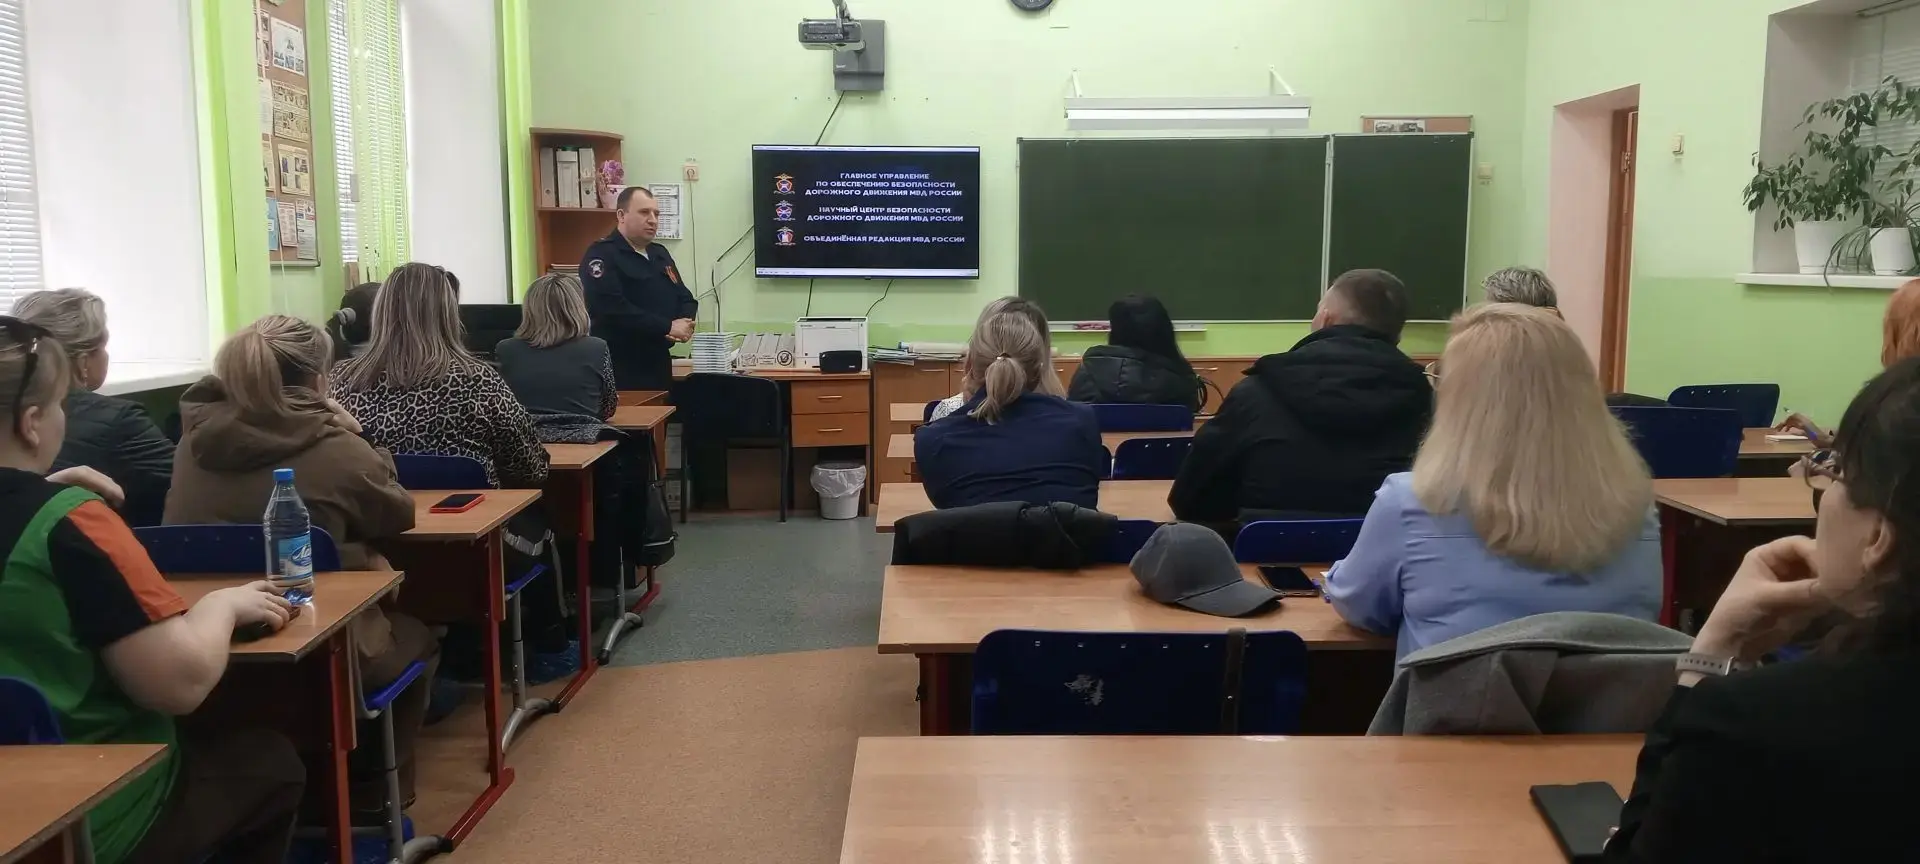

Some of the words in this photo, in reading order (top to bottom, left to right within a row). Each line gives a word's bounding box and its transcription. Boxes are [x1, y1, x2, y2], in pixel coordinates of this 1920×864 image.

[840, 172, 878, 180] ГЛАВНОЕ
[815, 180, 829, 188] ПО
[804, 188, 862, 196] ДОРОЖНОГО
[862, 189, 909, 197] ДВИЖЕНИЯ
[909, 189, 928, 197] МВД
[928, 189, 963, 197] РОССИИ
[819, 205, 859, 214] НАУЧНЫЙ
[806, 214, 863, 222] ДОРОЖНОГО
[864, 215, 910, 223] ДВИЖЕНИЯ
[910, 215, 929, 223] МВД
[803, 234, 868, 243] ОБЪЕДИНЁННАЯ
[868, 235, 912, 243] РЕДАКЦИЯ
